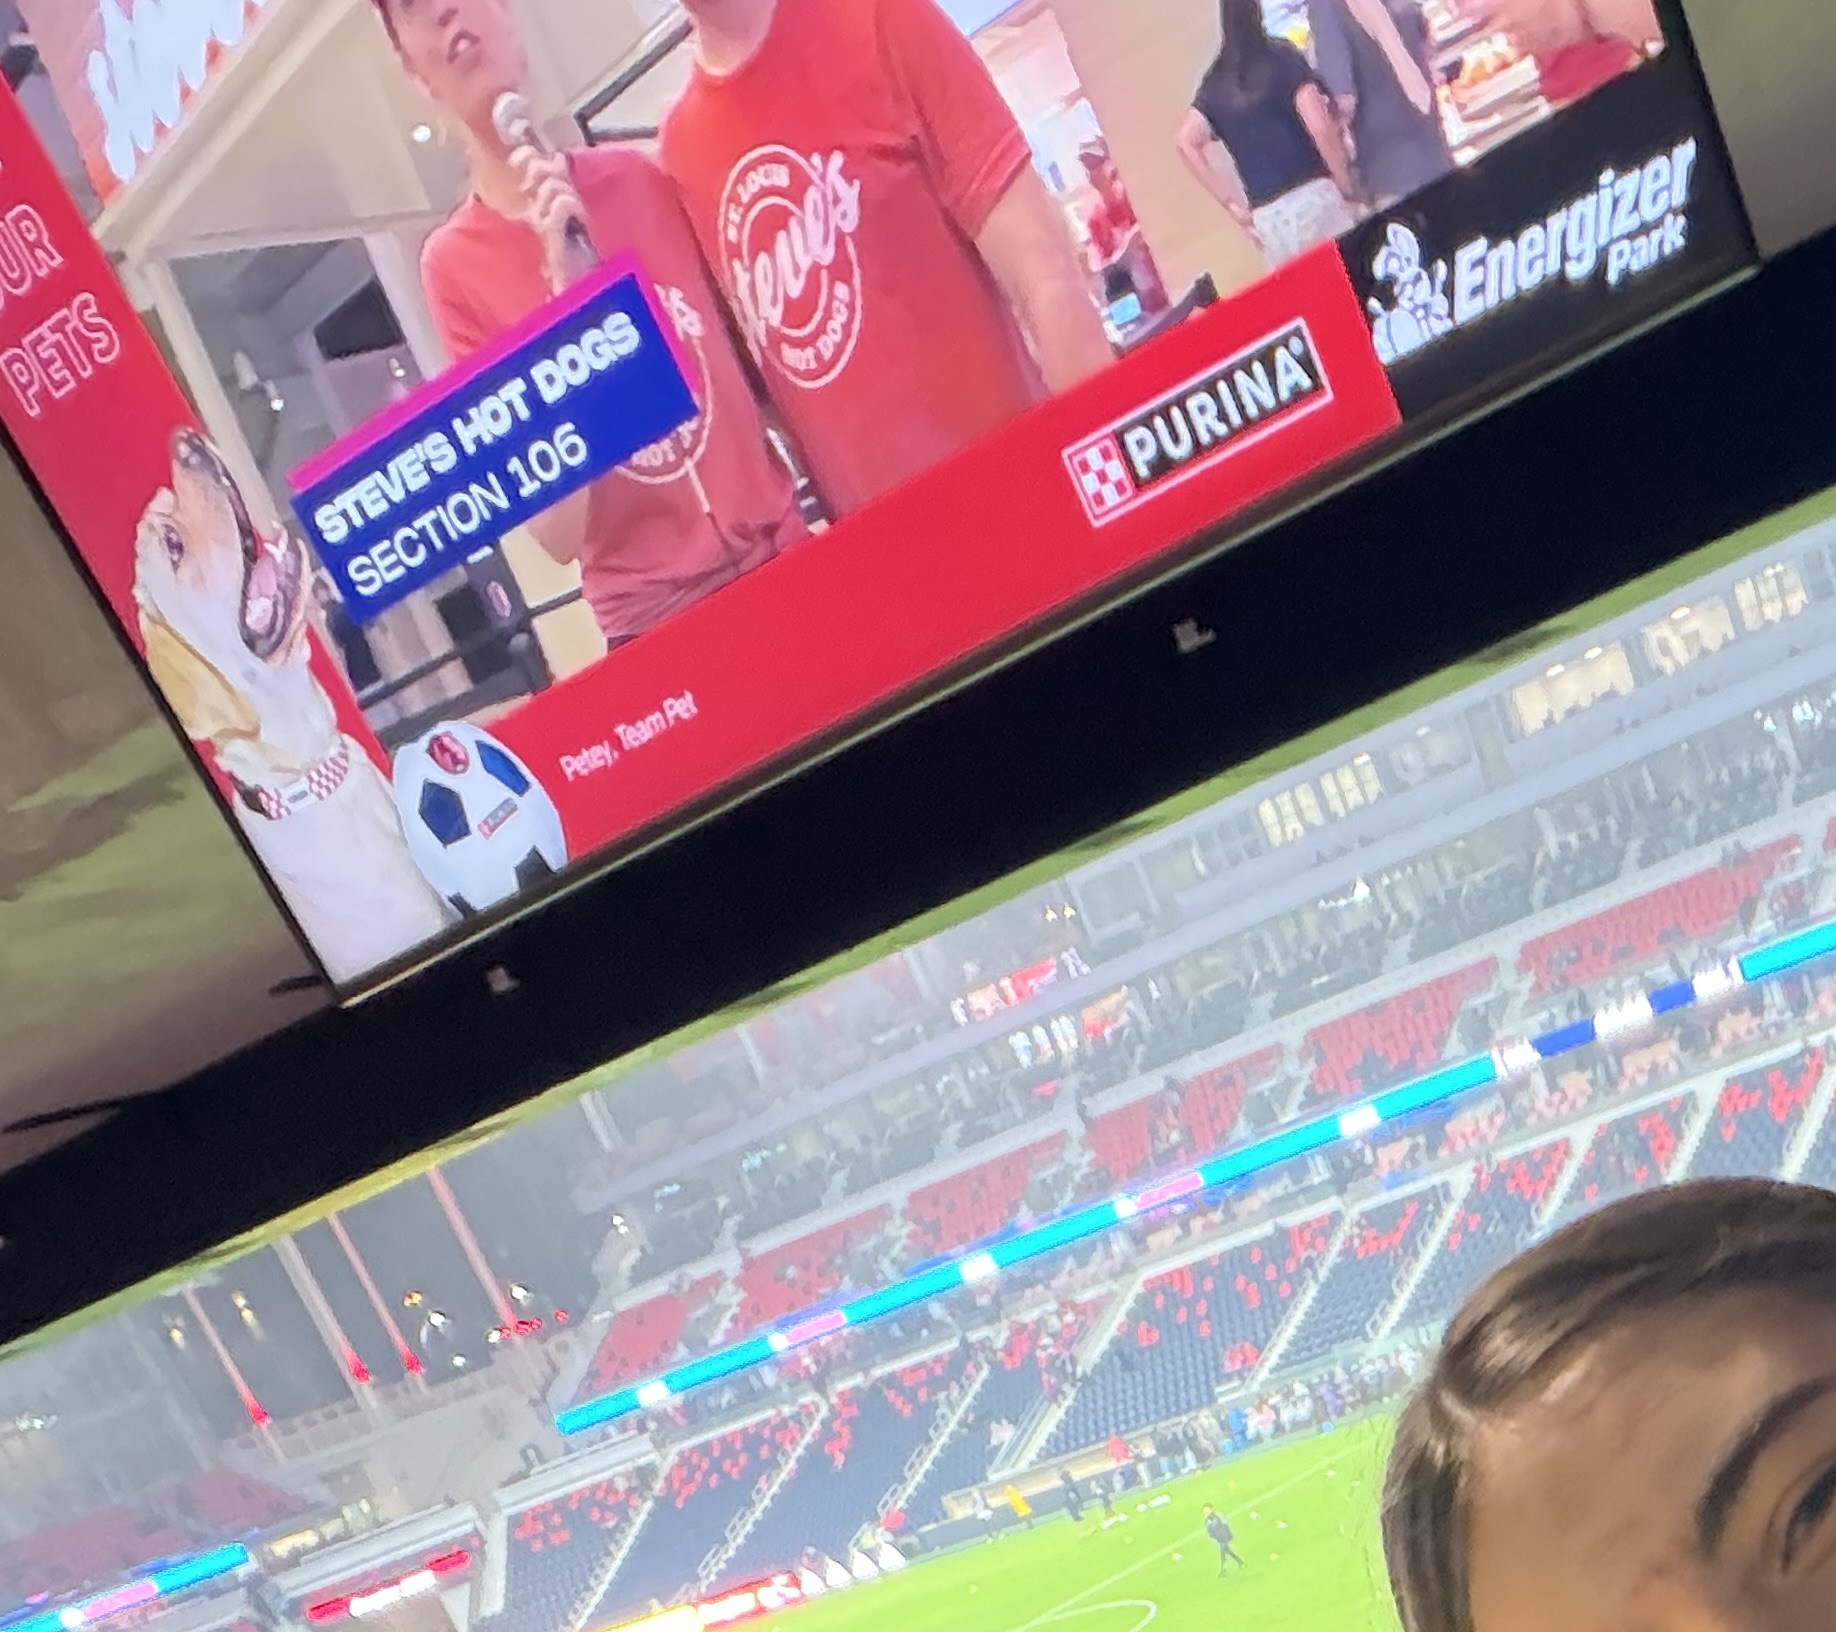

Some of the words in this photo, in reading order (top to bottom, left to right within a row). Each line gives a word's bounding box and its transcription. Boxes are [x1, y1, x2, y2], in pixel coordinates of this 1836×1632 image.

[1452, 136, 1697, 326] Energizer
[1605, 211, 1688, 287] Park
[0, 291, 121, 418] PETS
[313, 431, 458, 545] STEVE'S
[451, 376, 532, 456] HOT
[529, 311, 642, 404] DOGS
[346, 471, 511, 596] SECTION
[506, 421, 588, 499] 106
[558, 740, 620, 782] Petey,
[613, 710, 668, 751] Team
[661, 688, 699, 728] Pet
